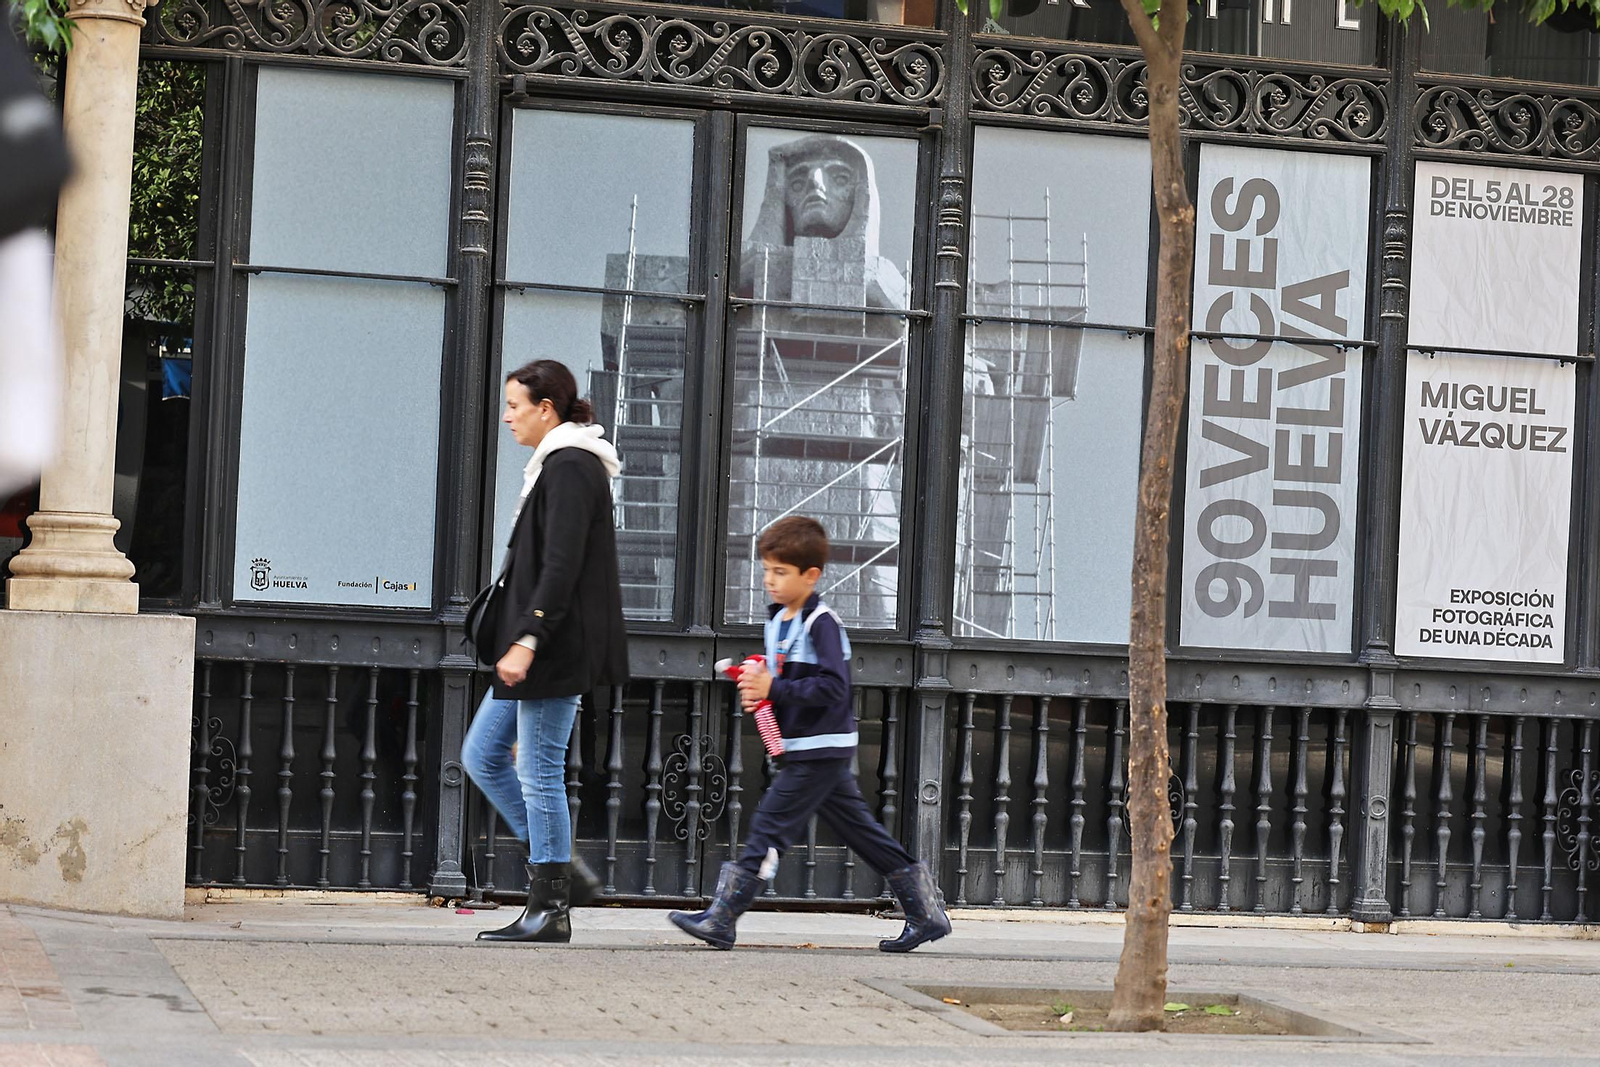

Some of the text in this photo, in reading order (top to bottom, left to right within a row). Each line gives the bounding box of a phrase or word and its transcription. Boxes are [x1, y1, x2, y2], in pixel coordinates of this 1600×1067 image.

[1431, 175, 1574, 209] DEL 5 AL 28
[1430, 200, 1573, 227] DE NOVIEMBRE
[1195, 176, 1281, 619] 90 VECES
[1420, 381, 1546, 415] MIGUEL
[1418, 411, 1568, 453] VÁZQUEZ
[1268, 269, 1350, 621] HUELVA
[273, 580, 308, 589] HUELVA
[337, 580, 373, 588] Fundación
[383, 580, 417, 592] Cajasol
[1450, 588, 1555, 608] EXPOSICIÓN
[1432, 607, 1554, 628] FOTOGRÁFICA
[1419, 627, 1553, 649] DE UNA DÉCADA
